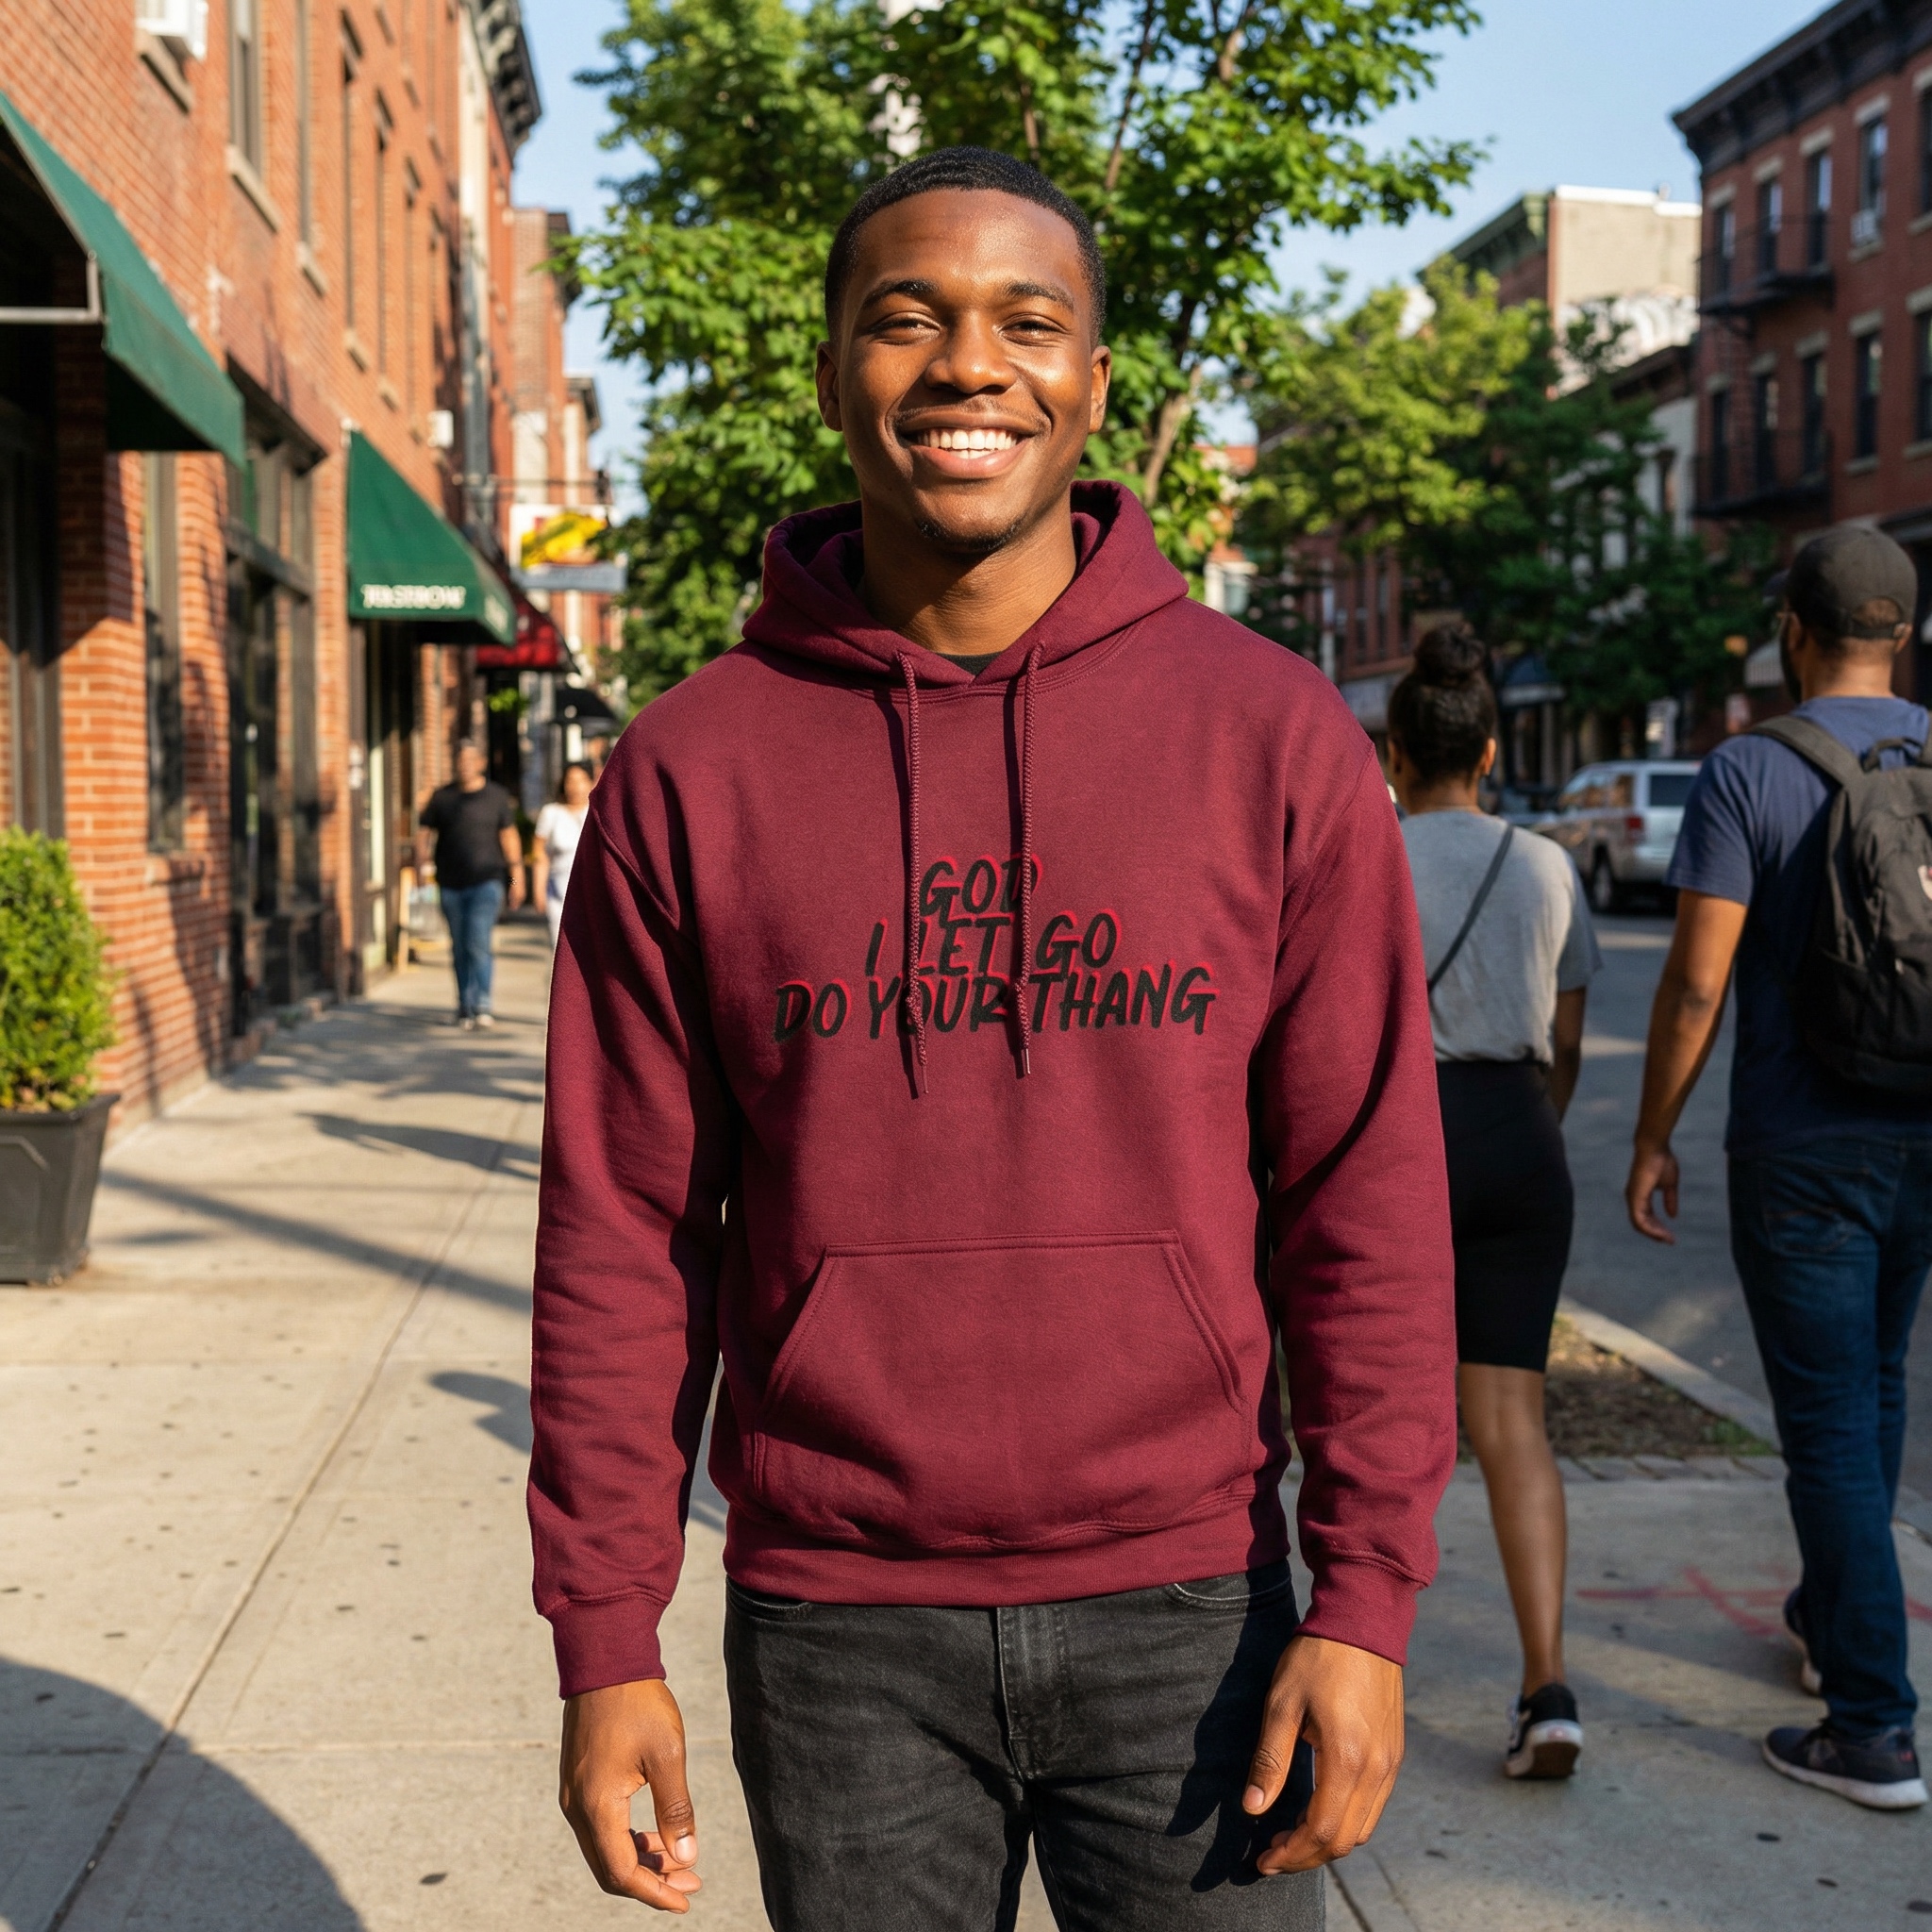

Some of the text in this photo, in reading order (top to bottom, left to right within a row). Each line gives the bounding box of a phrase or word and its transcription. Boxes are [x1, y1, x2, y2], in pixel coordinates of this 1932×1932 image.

[918, 854, 1043, 926] GOD
[865, 918, 889, 976] I
[1035, 909, 1123, 975] GO
[773, 958, 1221, 1041] DO YOUR THANG
